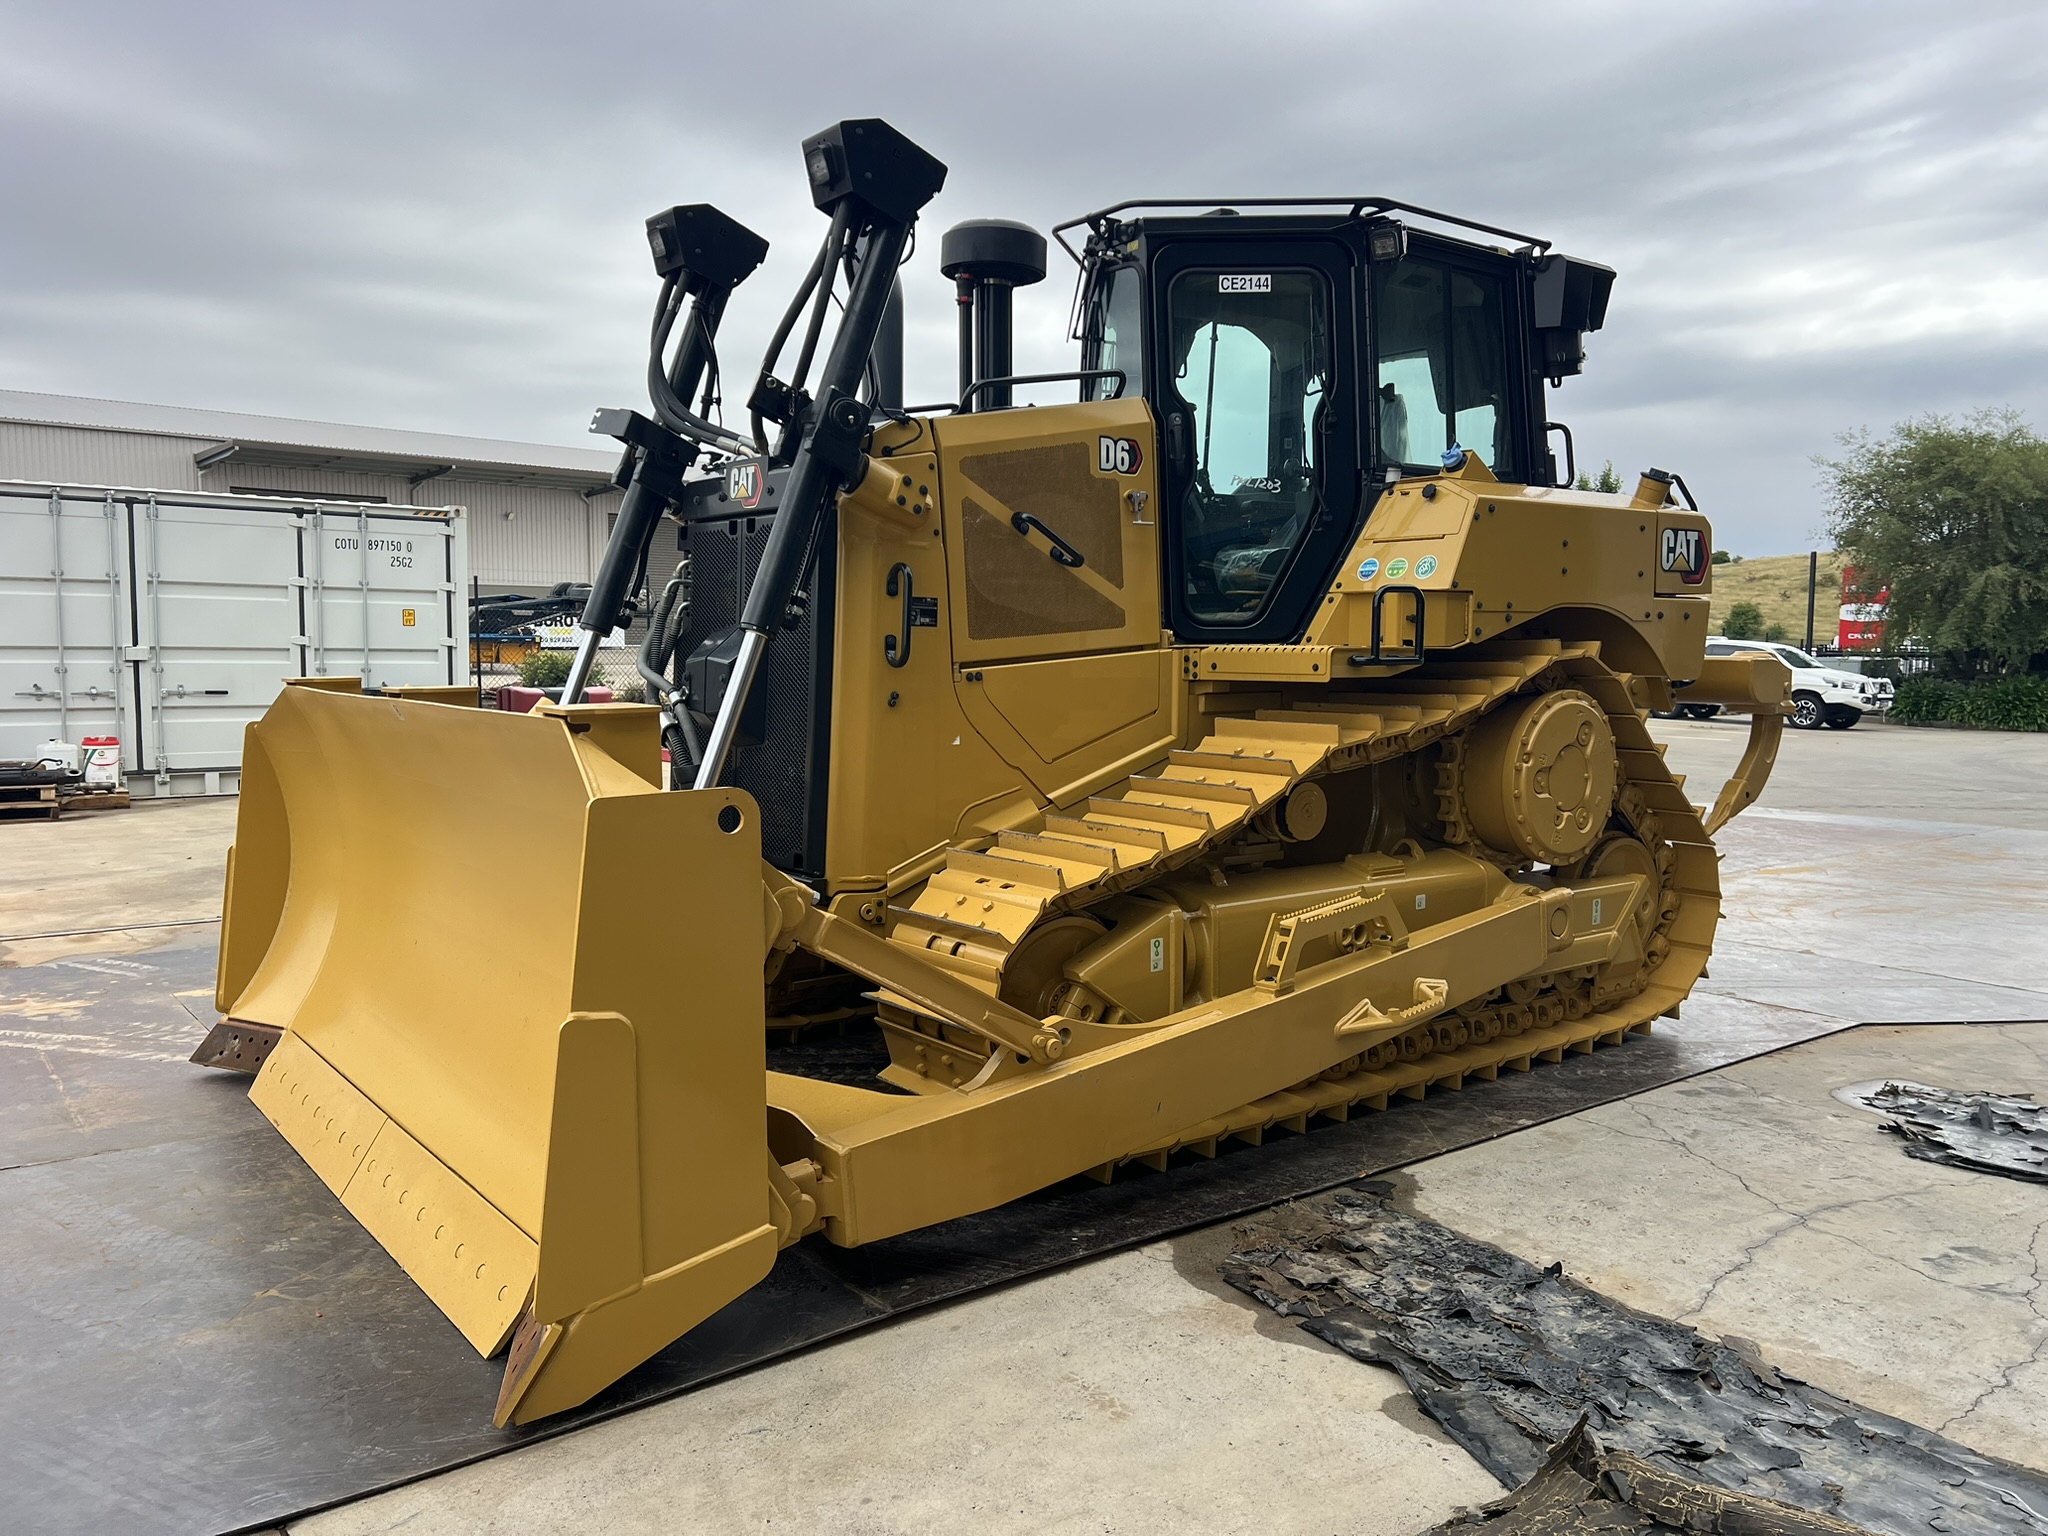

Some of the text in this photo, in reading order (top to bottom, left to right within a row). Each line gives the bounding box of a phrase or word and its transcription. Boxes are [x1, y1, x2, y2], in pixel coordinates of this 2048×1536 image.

[1220, 276, 1270, 291] CE2144
[1099, 435, 1131, 473] D6
[729, 465, 756, 499] CAT
[334, 538, 359, 550] COTU
[367, 540, 402, 552] 897150
[1661, 528, 1699, 572] CAT
[390, 556, 413, 568] 25G2
